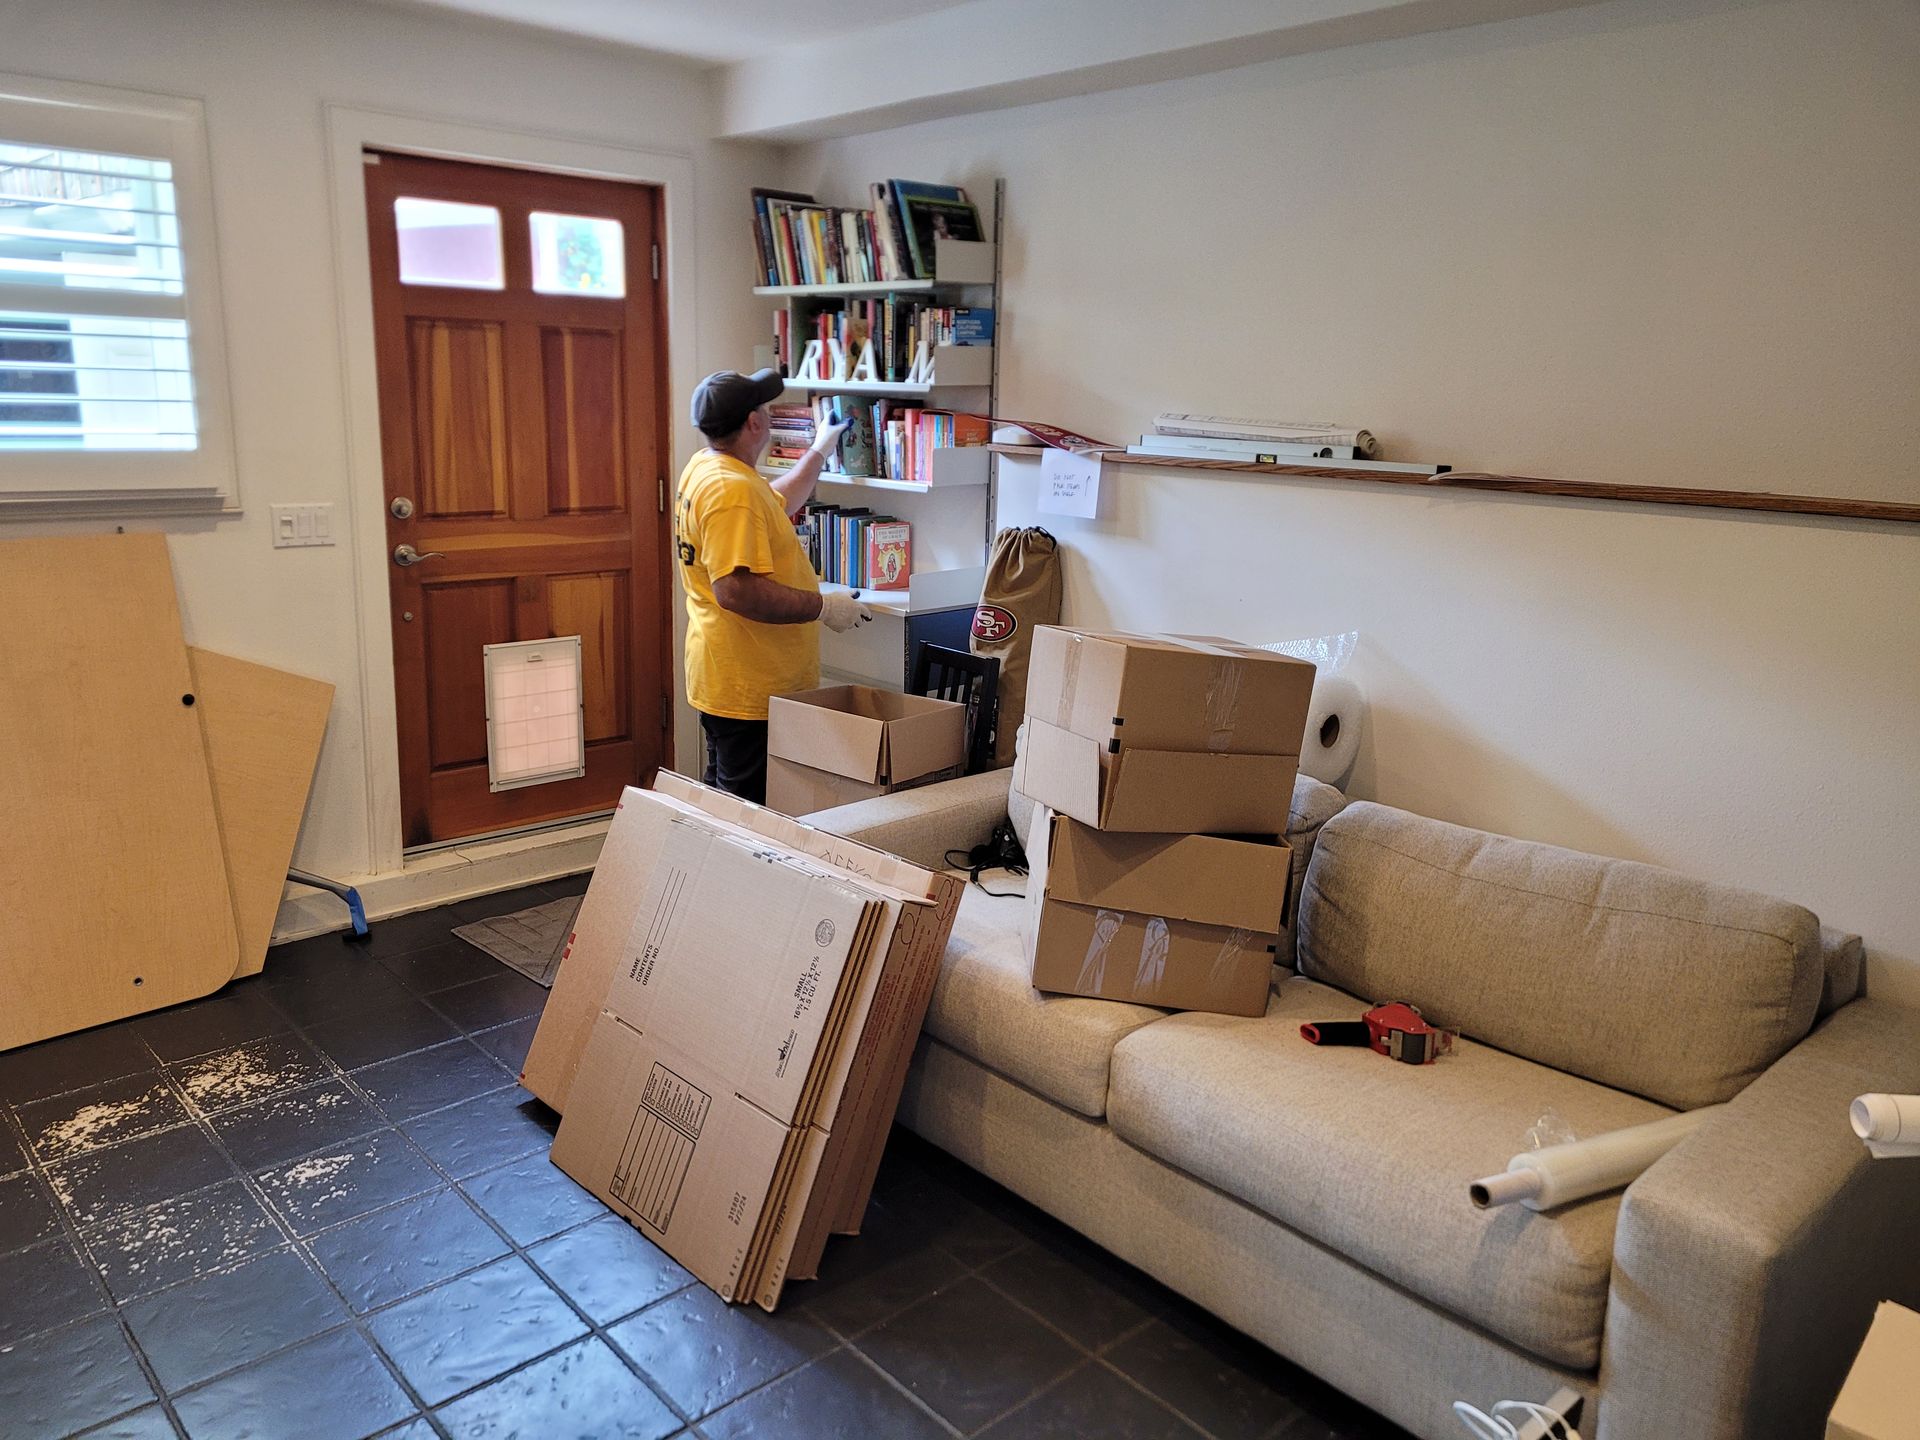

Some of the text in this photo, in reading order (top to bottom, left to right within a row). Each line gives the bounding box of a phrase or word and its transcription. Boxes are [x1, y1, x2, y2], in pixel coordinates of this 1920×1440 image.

[630, 957, 640, 978] NAME
[636, 944, 653, 982] CONTENTS
[642, 960, 654, 986] ORDER
[794, 972, 808, 998] SMALL
[803, 999, 812, 1011] 1.5
